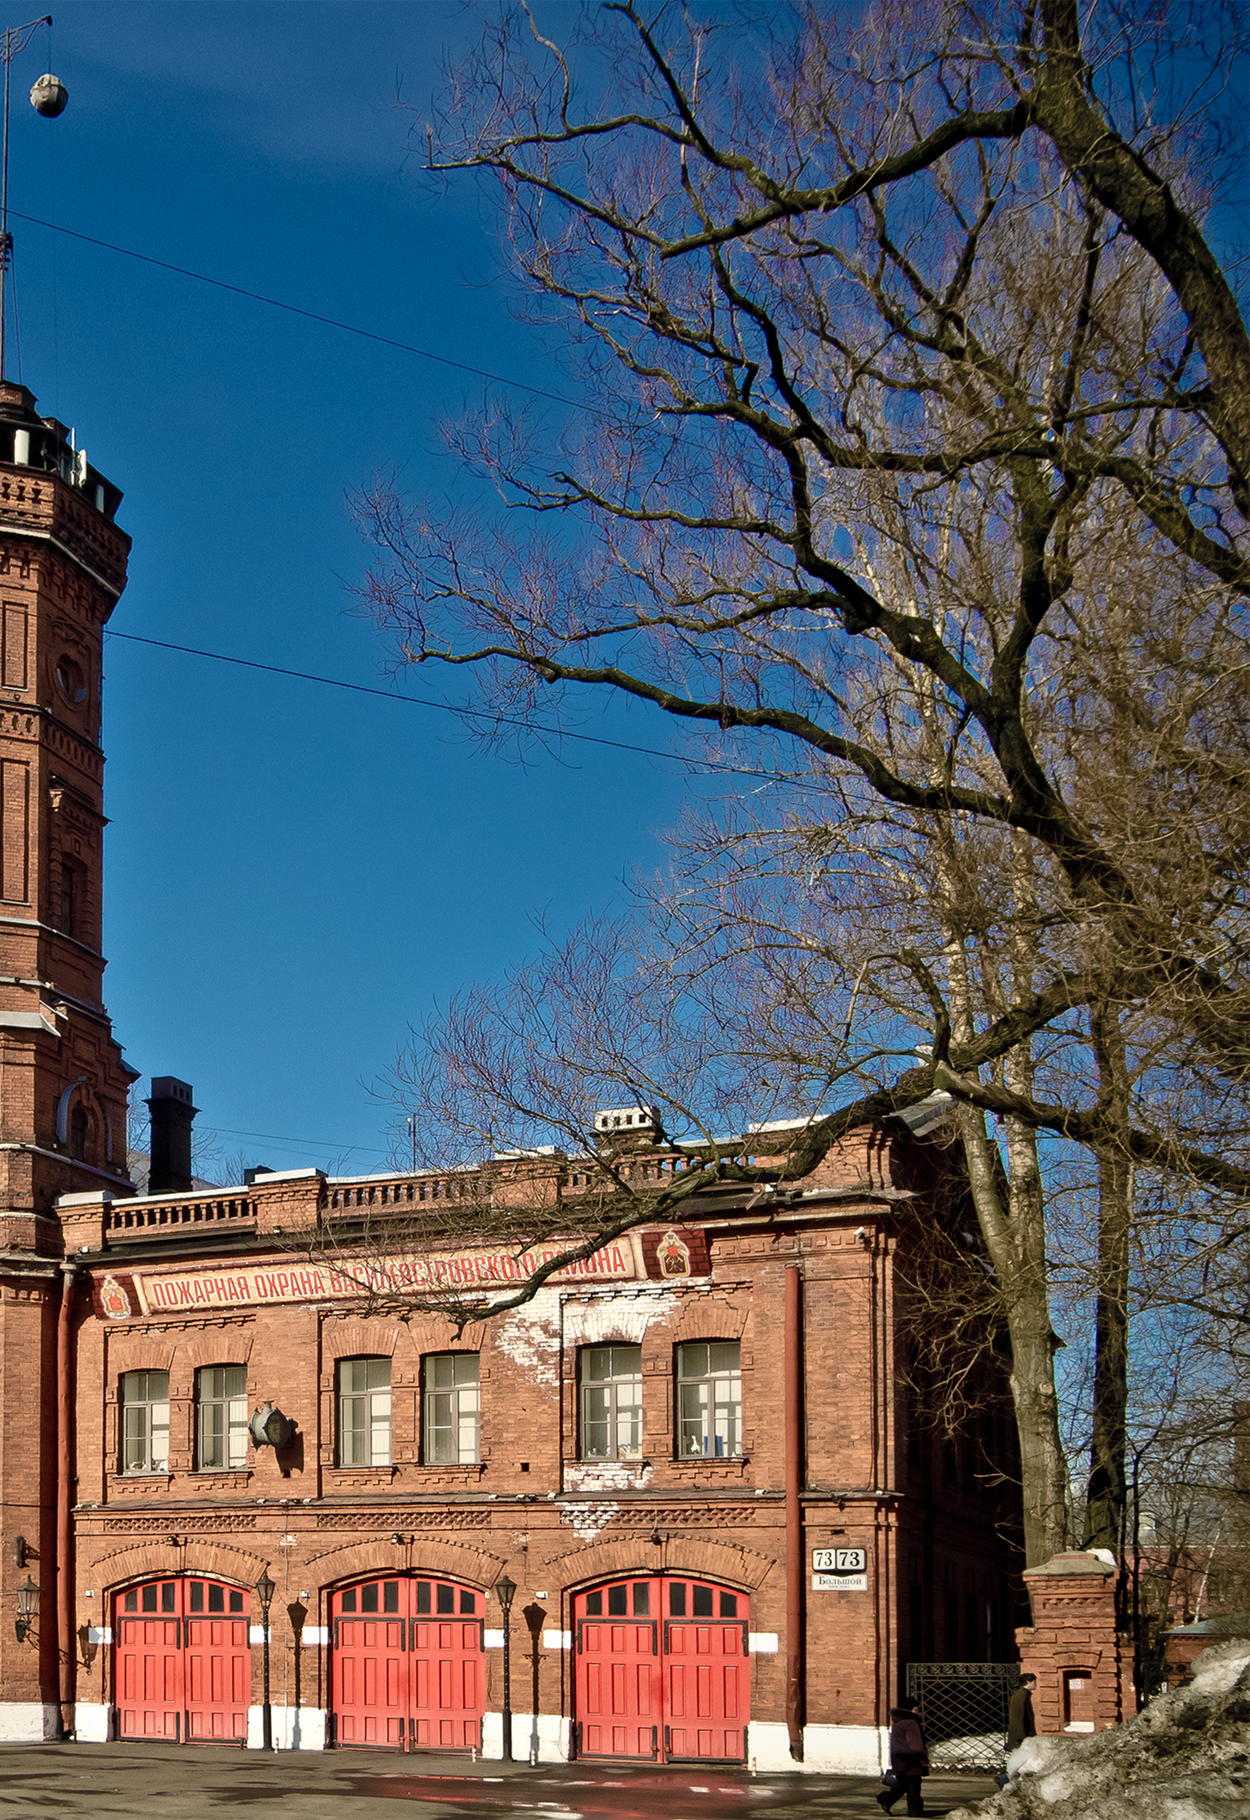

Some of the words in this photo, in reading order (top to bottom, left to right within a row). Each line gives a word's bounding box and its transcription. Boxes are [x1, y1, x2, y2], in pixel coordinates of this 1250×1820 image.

[152, 1273, 252, 1307] ПОЖАРНАЯ
[254, 1269, 326, 1298] ОХРАНА
[816, 1552, 832, 1567] 73
[839, 1552, 860, 1567] 73
[819, 1576, 862, 1585] Большой
